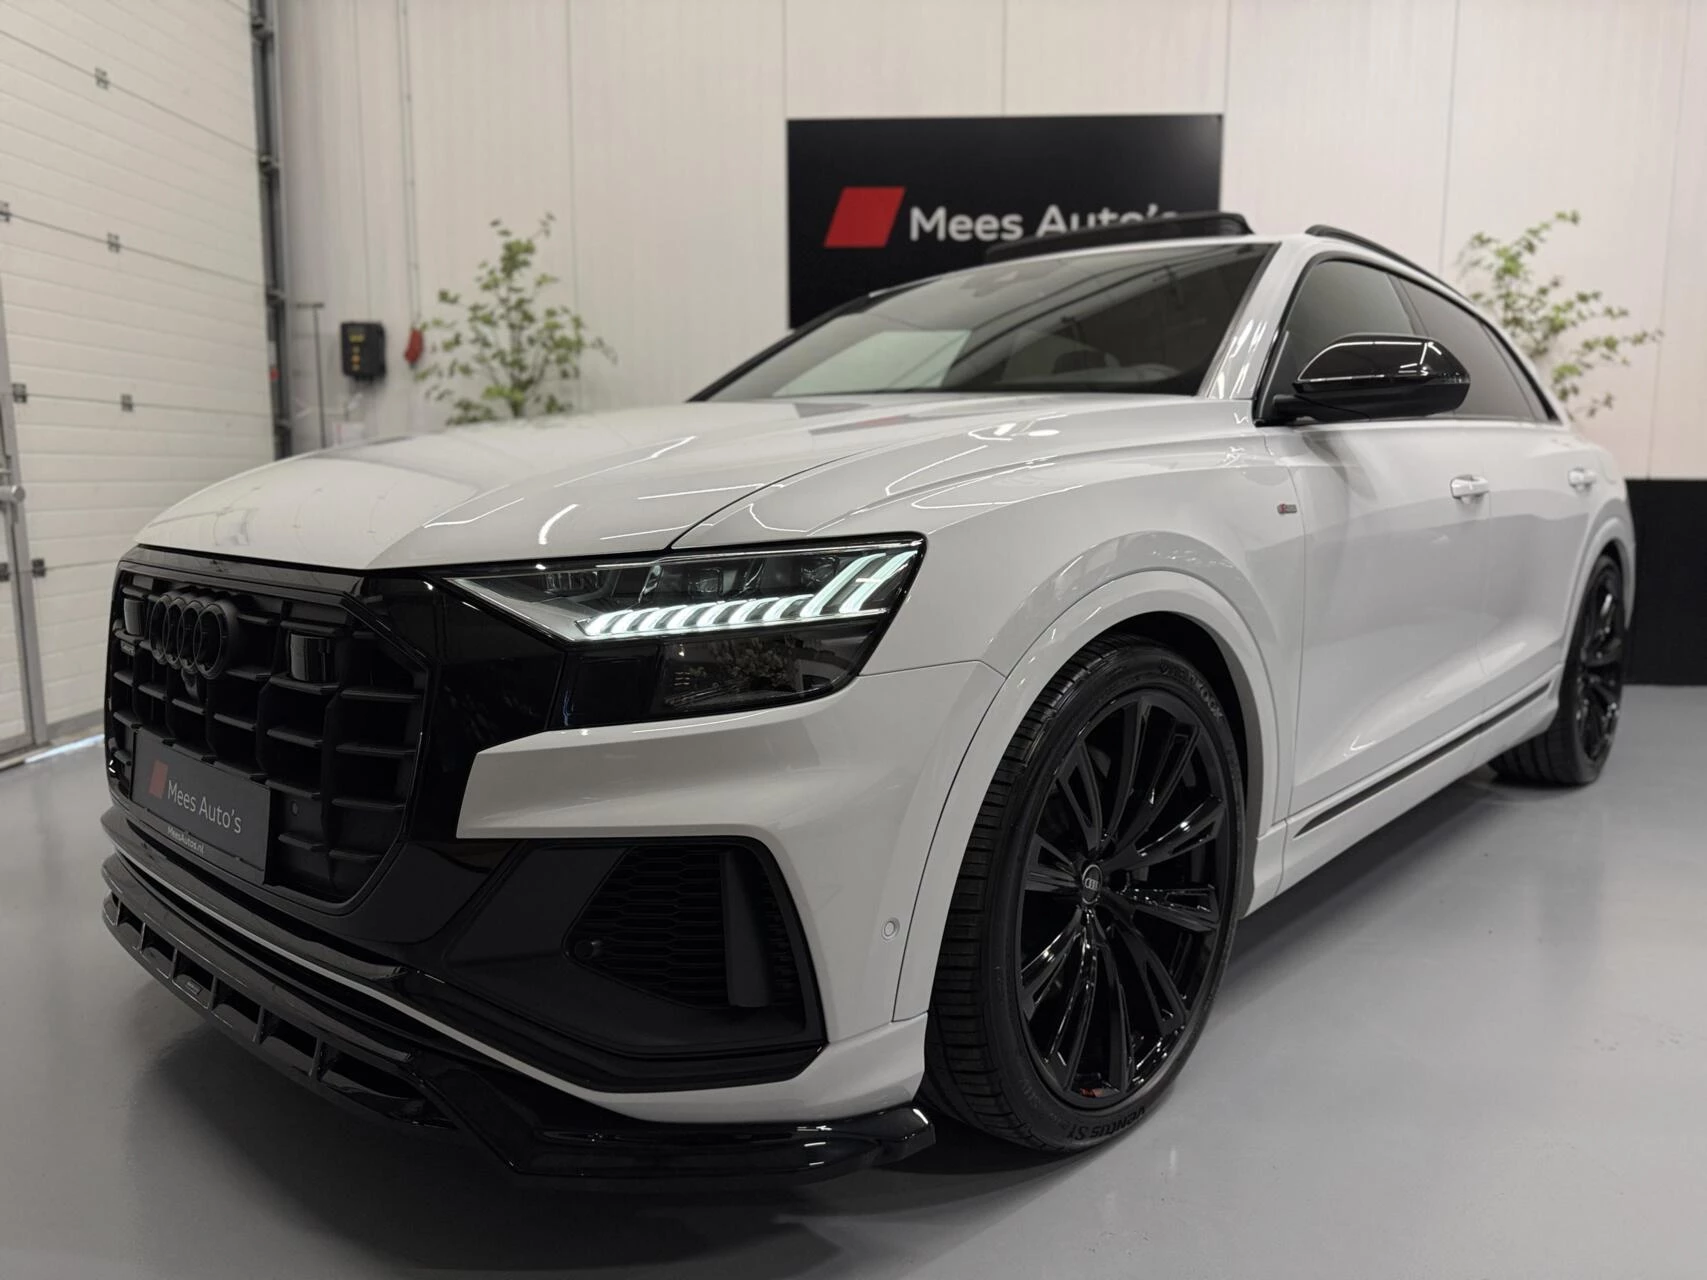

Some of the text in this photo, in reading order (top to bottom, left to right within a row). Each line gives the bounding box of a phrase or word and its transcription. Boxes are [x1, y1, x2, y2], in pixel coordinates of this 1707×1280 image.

[909, 203, 1180, 241] Mees Aut'
[167, 779, 242, 834] Mees Auto's
